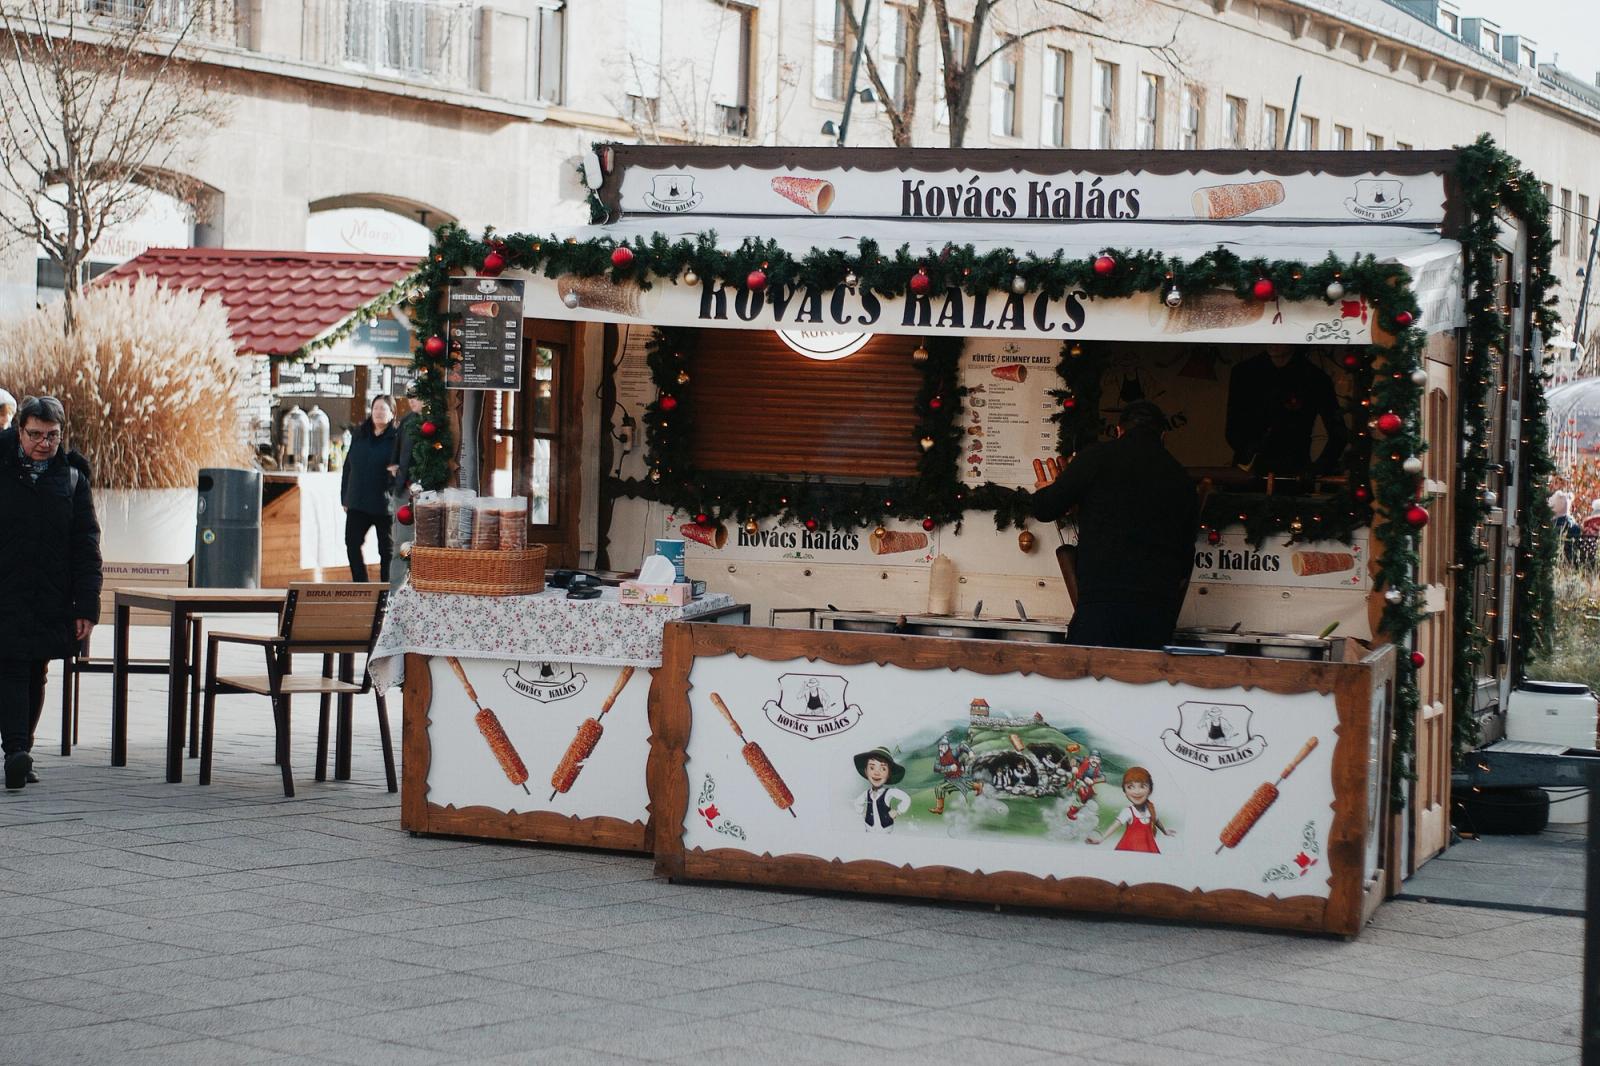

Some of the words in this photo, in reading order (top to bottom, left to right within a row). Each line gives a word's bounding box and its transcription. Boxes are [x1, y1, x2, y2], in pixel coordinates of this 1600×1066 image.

[901, 174, 1017, 217] Kovács
[1027, 176, 1140, 219] Kalács
[1001, 355, 1030, 364] CHIMNEY
[1031, 356, 1051, 364] CAKES
[738, 527, 797, 549] Kovács
[801, 530, 859, 551] Kalács
[131, 567, 169, 575] MORETTI
[1218, 549, 1280, 572] Kalács
[515, 680, 542, 697] KOVÁCS
[548, 683, 577, 698] KALÁCS
[777, 714, 809, 733] KOVÁCS
[816, 717, 850, 734] KALÁCS
[1175, 743, 1210, 764] KOVÁCS
[1218, 748, 1254, 765] KALÁCS
